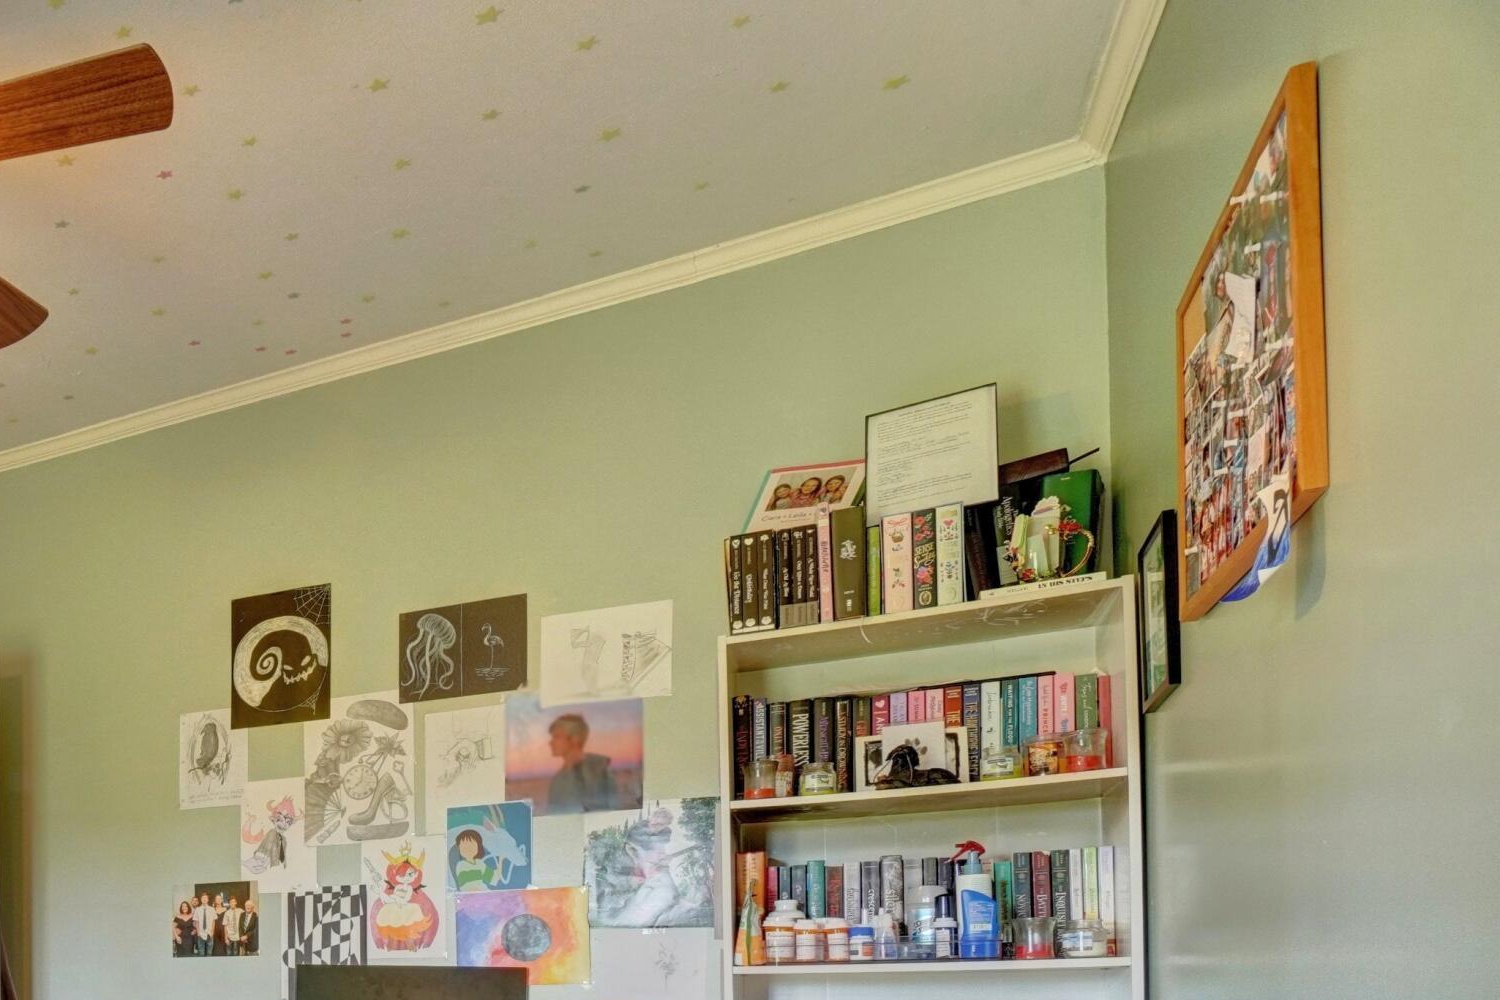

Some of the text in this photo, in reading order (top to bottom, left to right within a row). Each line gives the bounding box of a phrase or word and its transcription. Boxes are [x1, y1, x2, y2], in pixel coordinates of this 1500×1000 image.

[755, 704, 765, 738] ASSISTANT
[838, 716, 846, 739] STUDY
[947, 710, 960, 723] THE
[792, 713, 809, 767] POWERLESS
[1016, 894, 1028, 918] NOVIC
